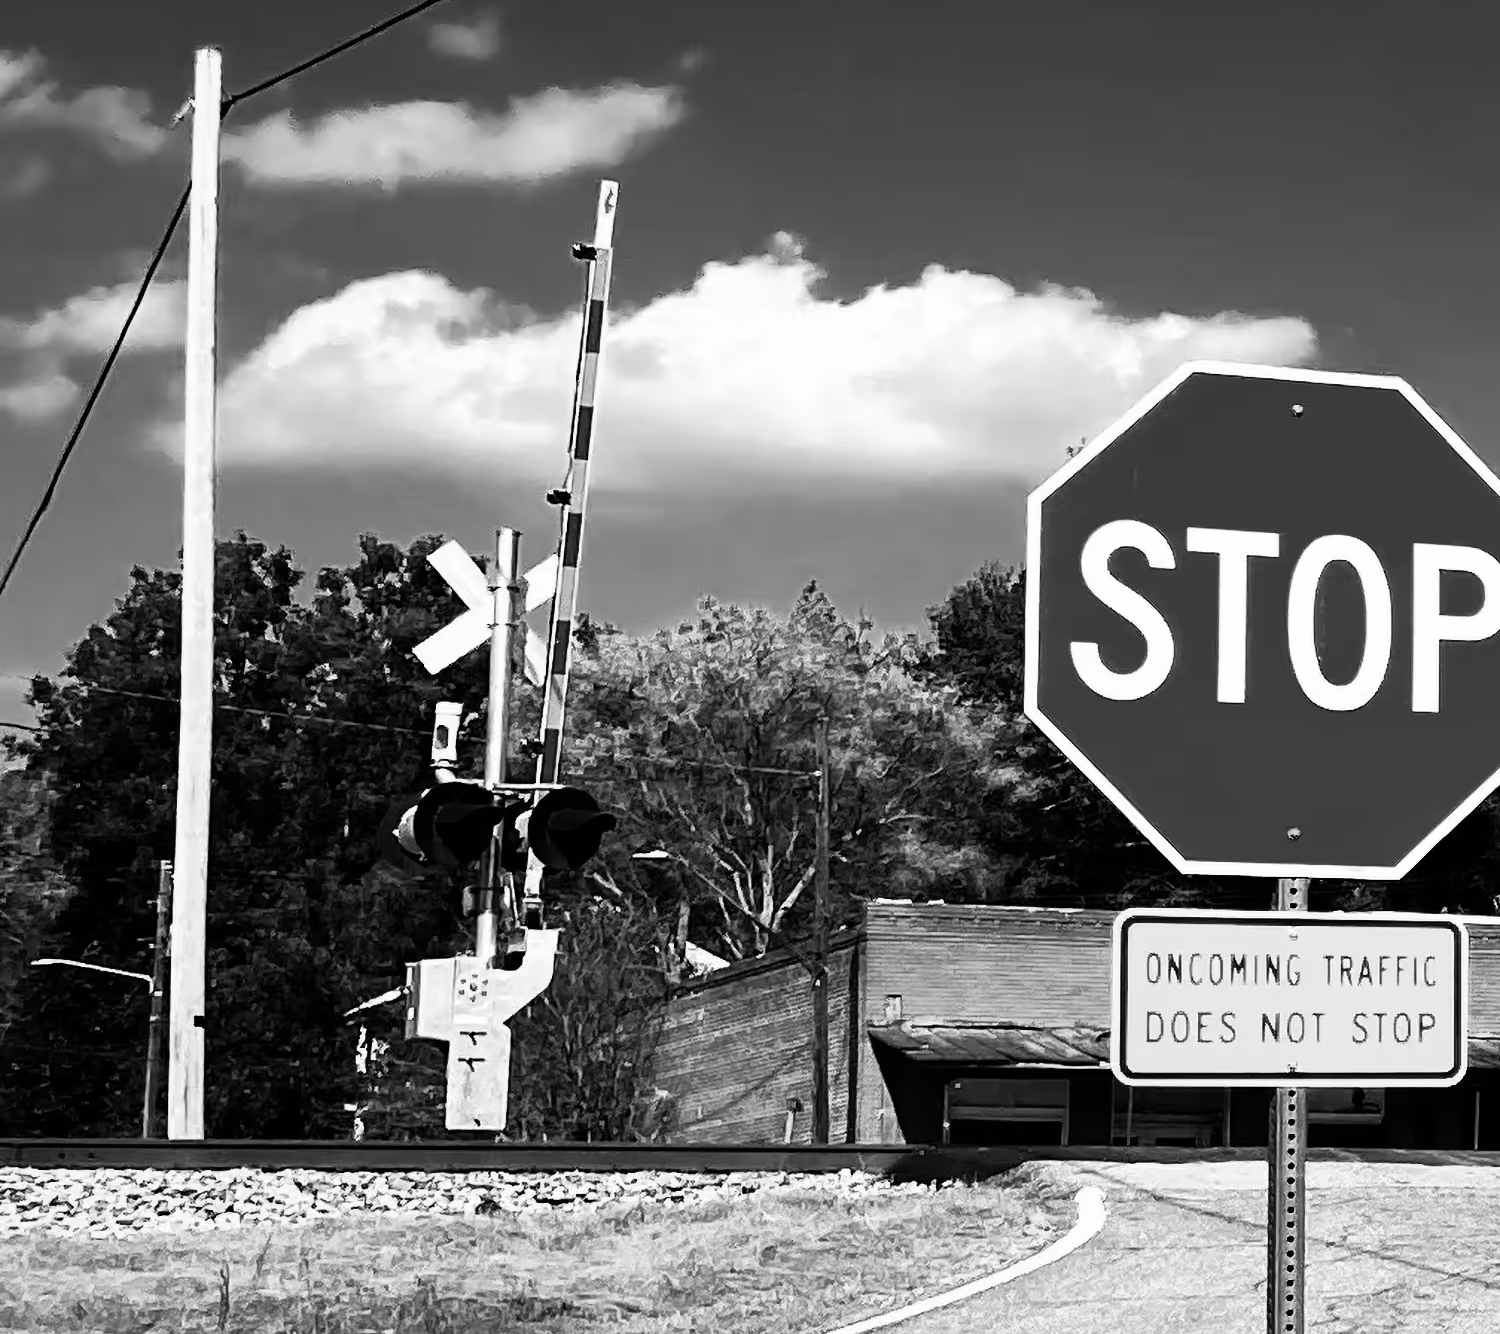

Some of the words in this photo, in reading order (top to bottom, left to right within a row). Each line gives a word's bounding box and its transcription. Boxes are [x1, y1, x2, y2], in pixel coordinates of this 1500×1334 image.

[1147, 953, 1301, 987] ONCOMING
[1323, 955, 1436, 987] TRAFFIC
[1146, 1011, 1236, 1044] DOES
[1261, 1012, 1326, 1044] NOT
[1352, 1012, 1436, 1044] STOP
